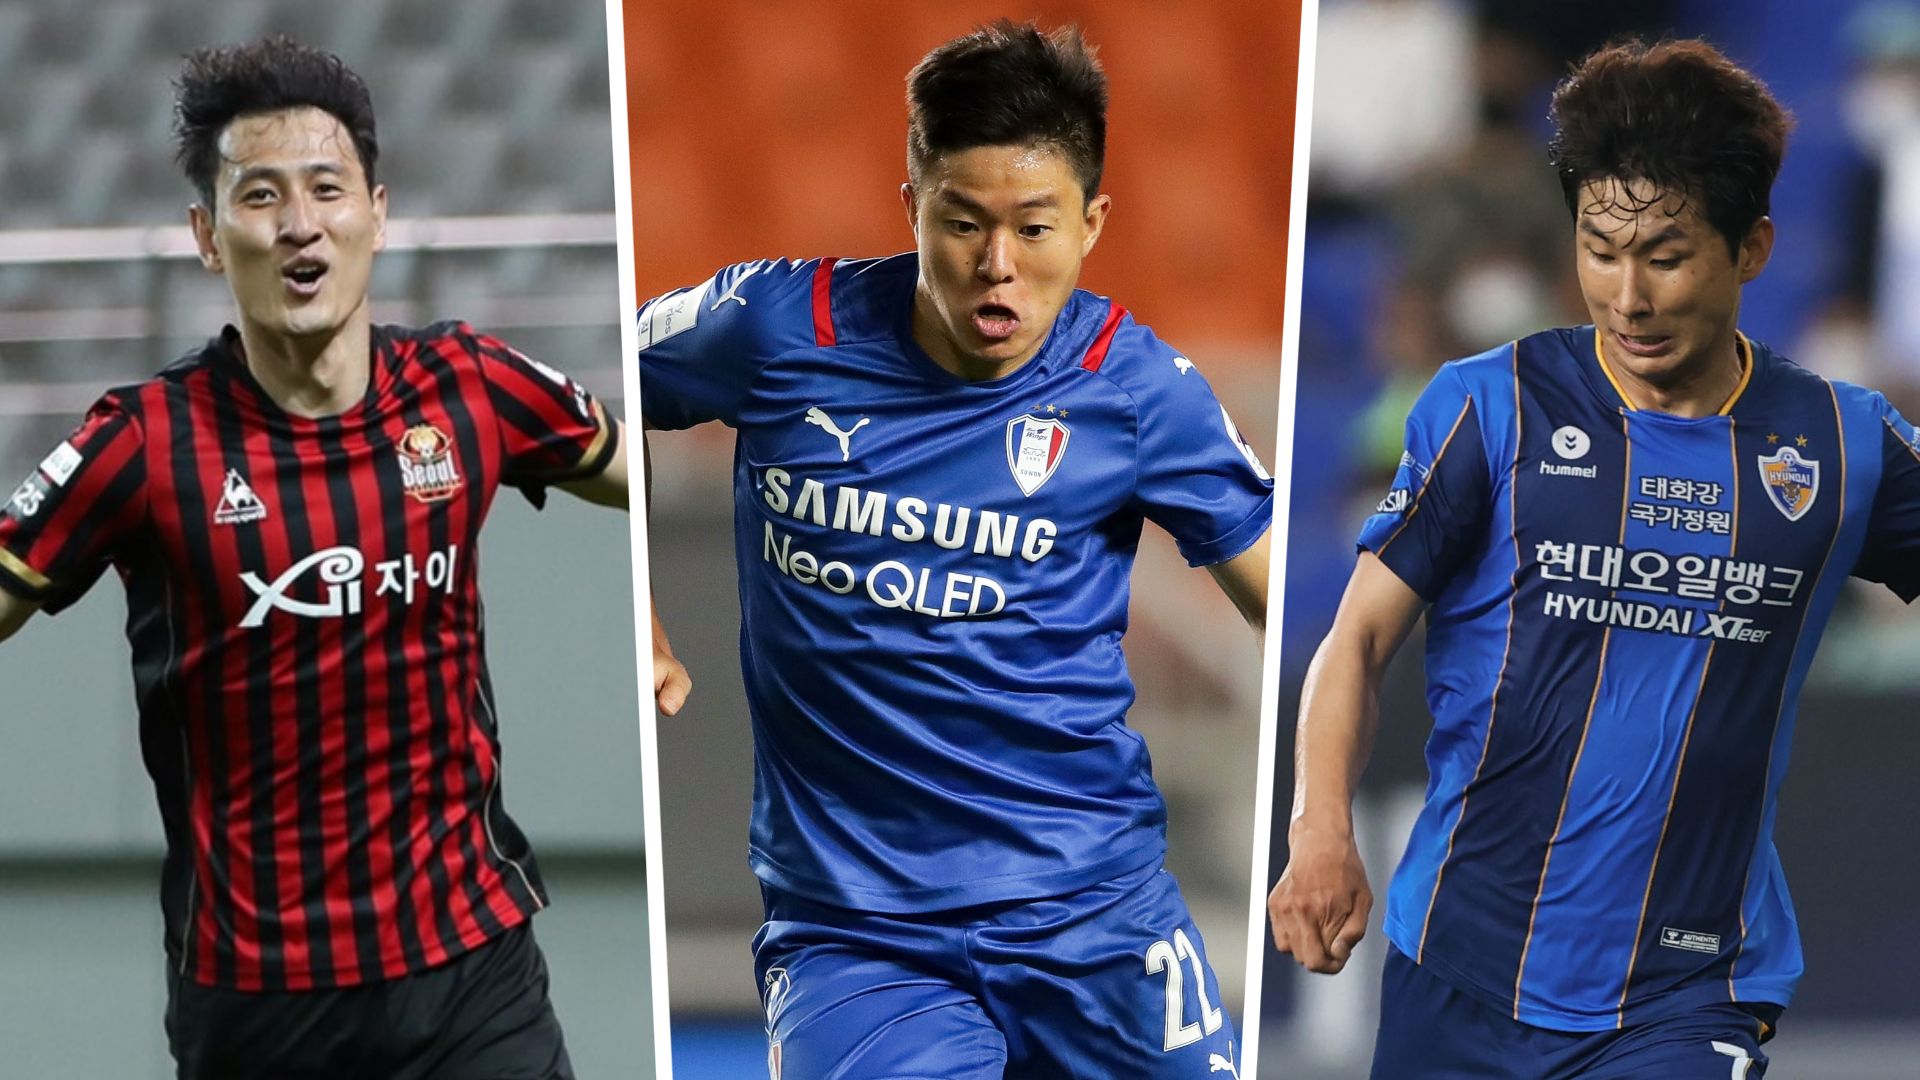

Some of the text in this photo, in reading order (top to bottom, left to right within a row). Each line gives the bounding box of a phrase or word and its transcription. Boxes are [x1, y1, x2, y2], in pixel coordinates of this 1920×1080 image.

[398, 449, 460, 487] Seoul
[1539, 461, 1597, 478] hummel
[1640, 477, 1723, 505] 태화강
[1770, 471, 1810, 486] HYUNDAI
[764, 468, 1058, 563] SAMSUNG
[1630, 503, 1731, 533] 국가정원
[375, 544, 457, 605] 자이
[764, 520, 1006, 618] Neo QLED
[1535, 540, 1804, 607] 현대오일뱅크
[1543, 592, 1772, 643] HYUNDAI XTeer
[1145, 928, 1223, 1052] 22
